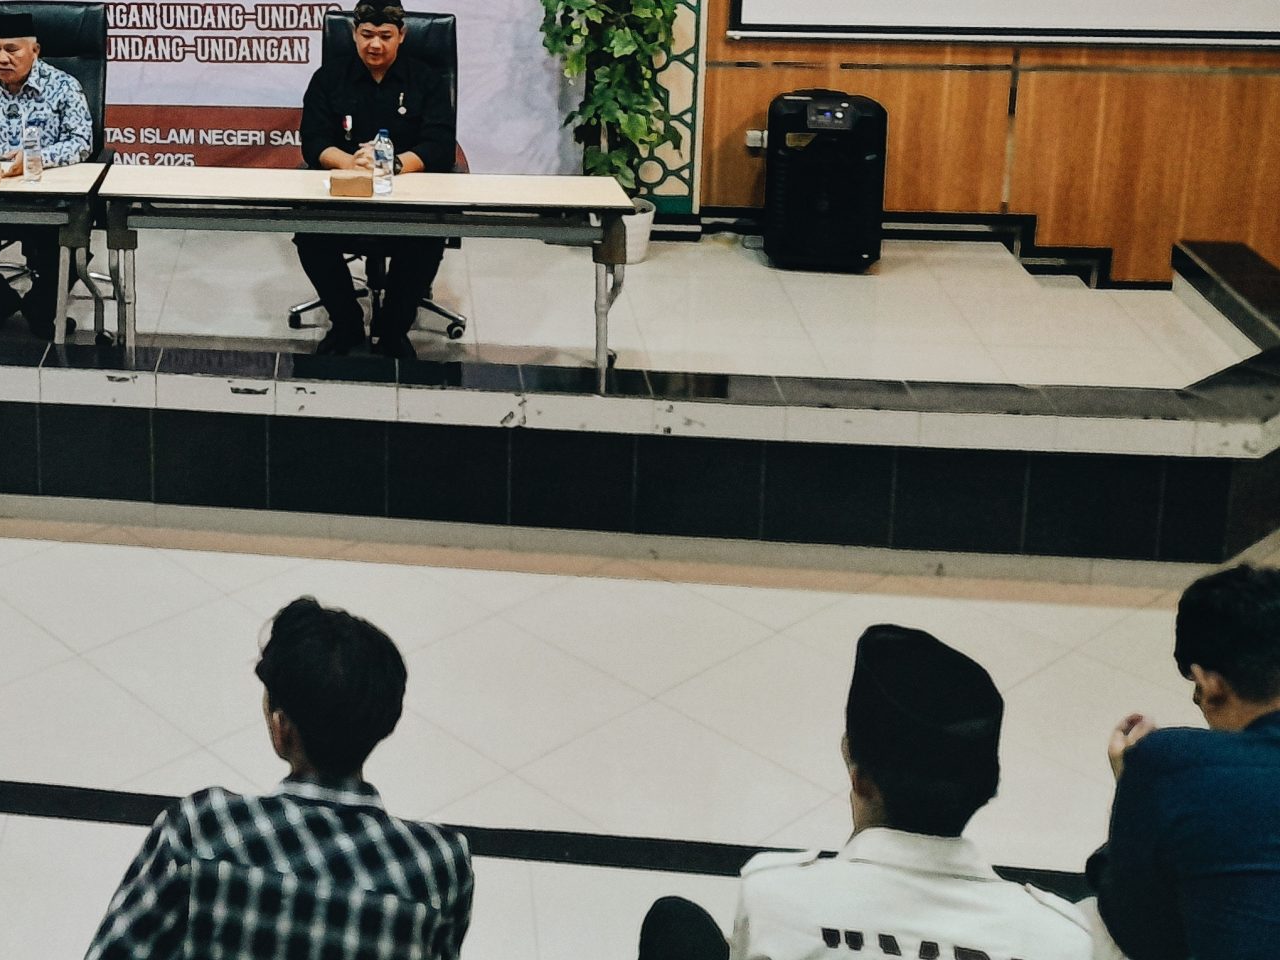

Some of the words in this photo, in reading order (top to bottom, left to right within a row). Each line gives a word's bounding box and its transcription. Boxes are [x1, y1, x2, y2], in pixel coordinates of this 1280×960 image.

[159, 3, 342, 30] UNDANG-UNDAN
[140, 127, 196, 145] ISLAM
[198, 128, 267, 146] NEGERI
[153, 152, 197, 168] 2025
